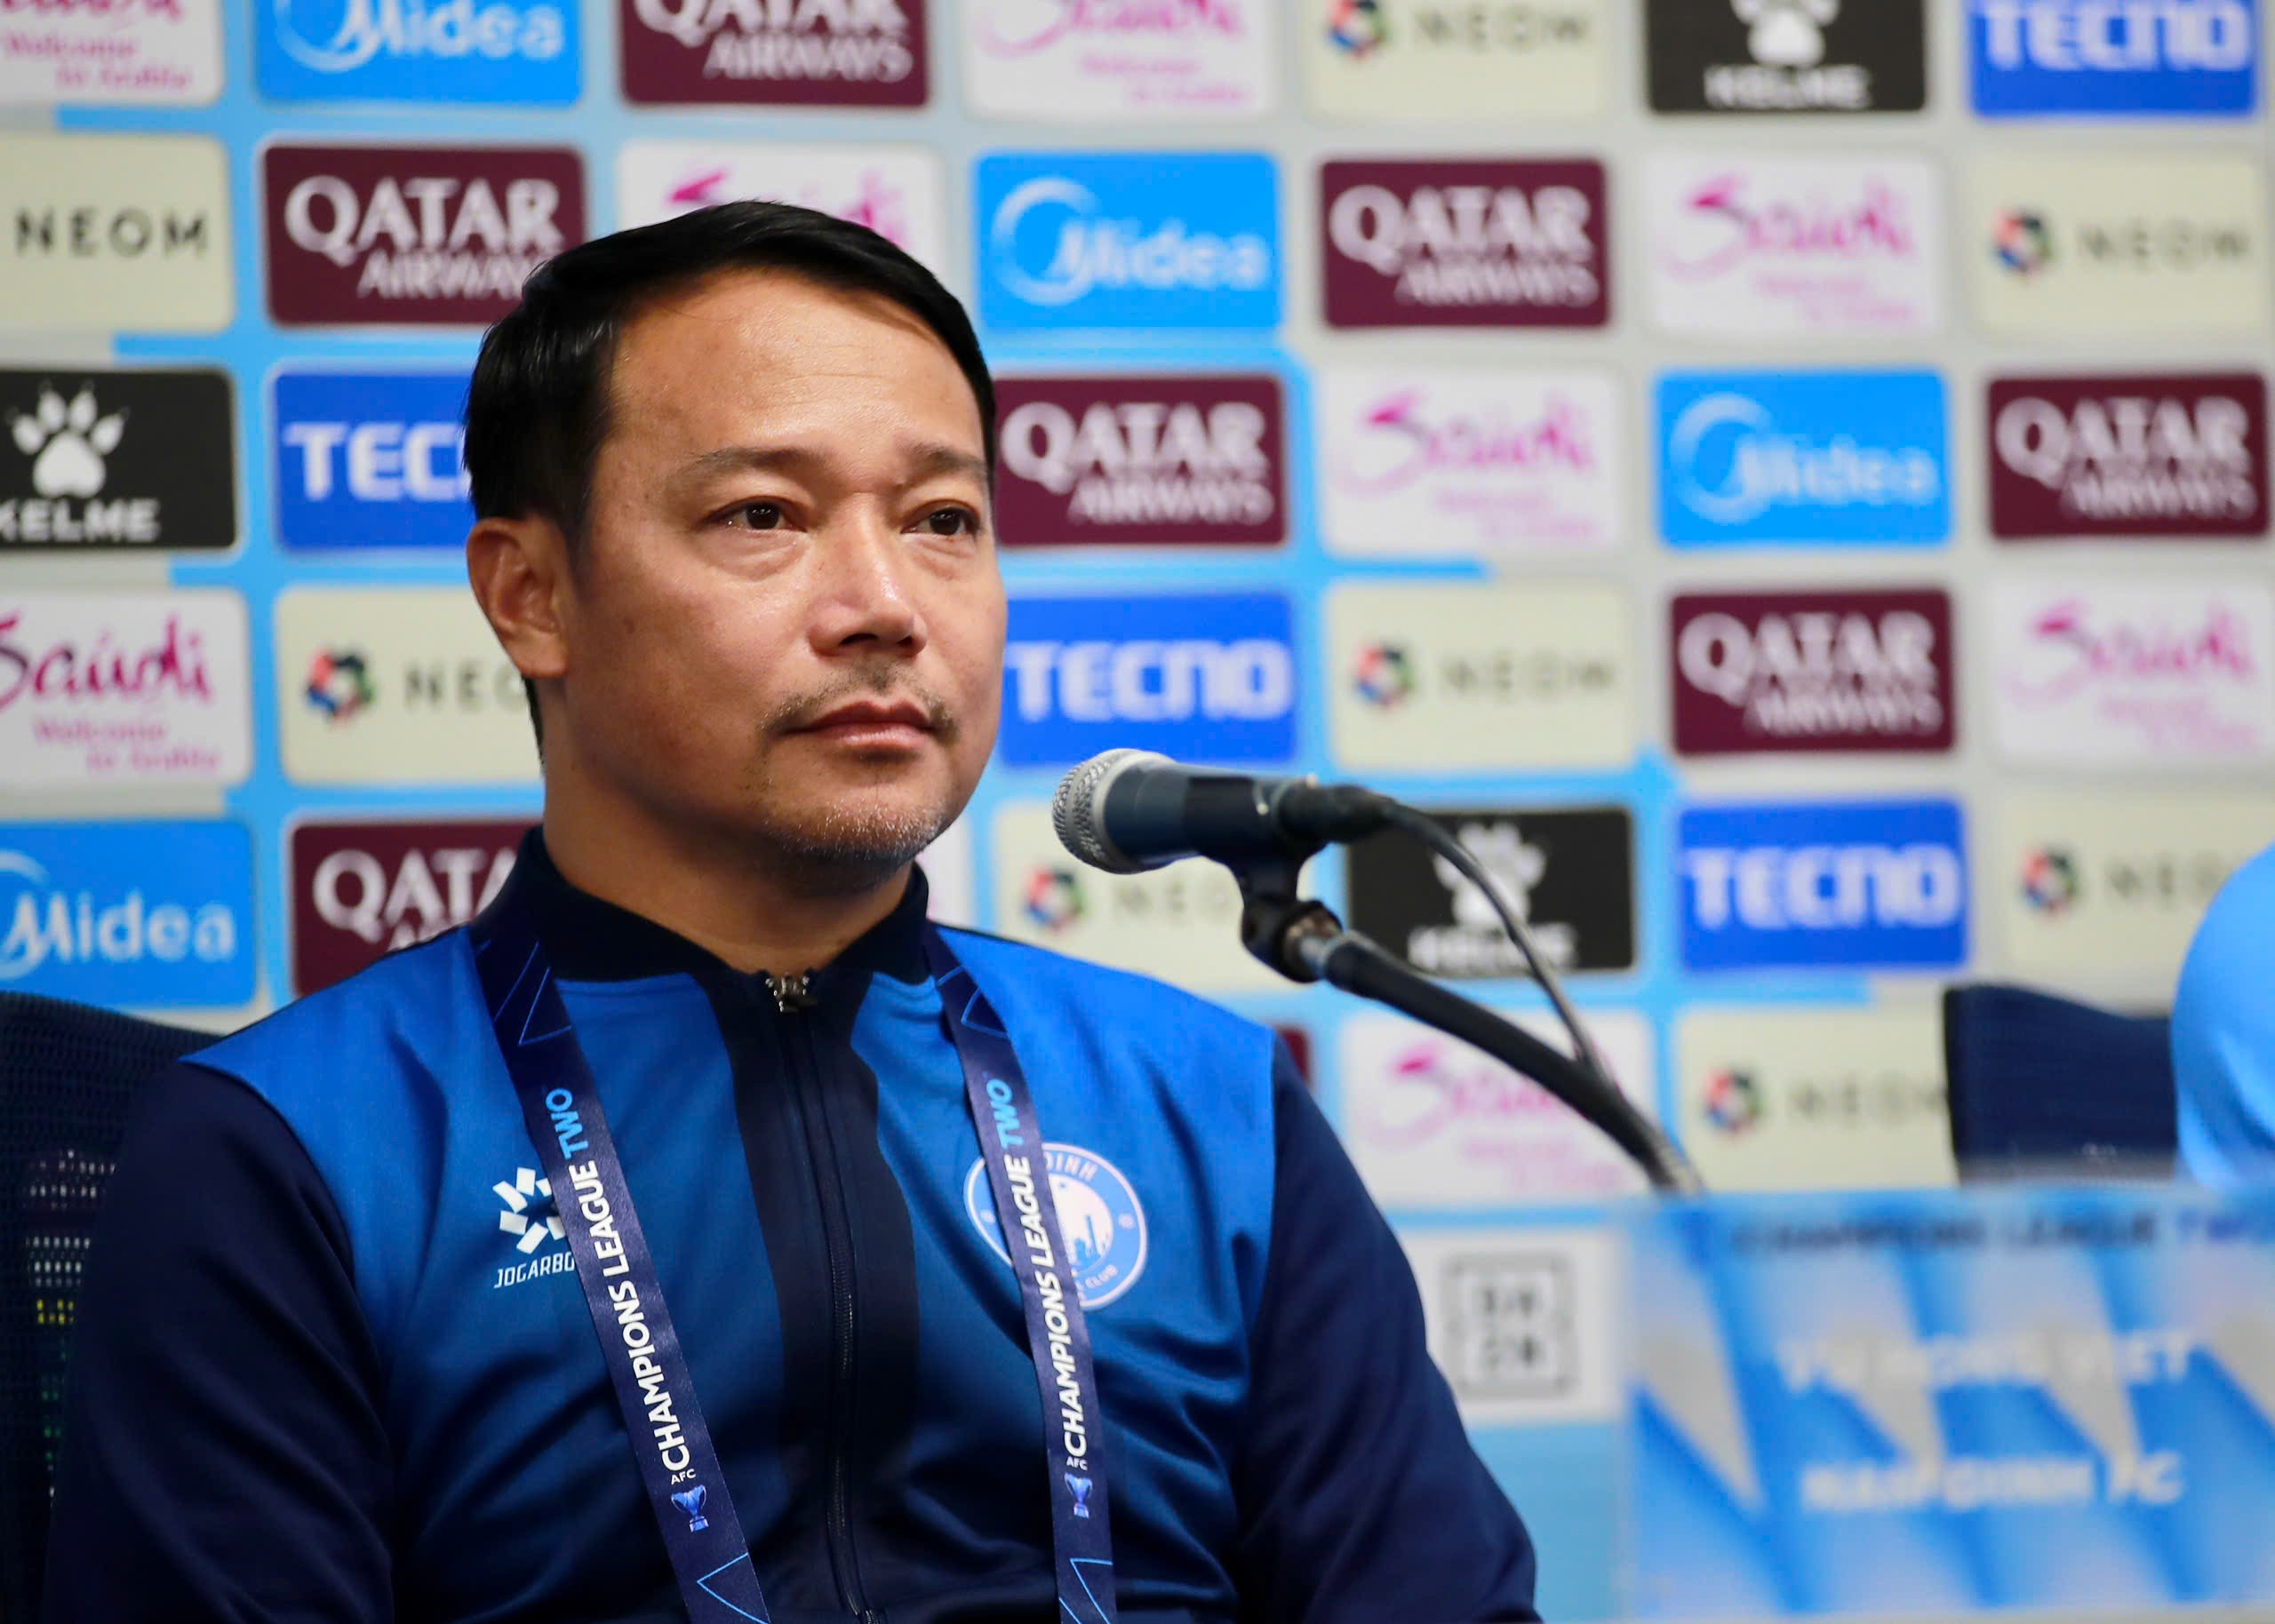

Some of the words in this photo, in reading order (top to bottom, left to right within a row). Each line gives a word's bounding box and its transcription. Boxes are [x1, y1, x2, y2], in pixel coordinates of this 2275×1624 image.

[15, 206, 210, 258] NEOM
[285, 175, 564, 267] QATAR
[1330, 185, 1595, 276] QATAR
[283, 422, 473, 503] TEC
[1001, 402, 1269, 495] QATAR
[1996, 396, 2252, 490] QATAR
[404, 657, 528, 711] NEO
[1007, 639, 1294, 722] TECNO
[1677, 610, 1939, 708] QATAR
[0, 886, 238, 970] Midea
[312, 848, 519, 944] QAT
[1682, 843, 1964, 930] TECNO
[545, 1087, 589, 1159] TWO
[986, 1079, 1024, 1150] TWO
[568, 1159, 630, 1278] LEAGUE
[1004, 1154, 1057, 1269] LEAGUE
[493, 1250, 576, 1289] JOGARBO
[608, 1280, 690, 1471] CHAMPIONS
[1034, 1270, 1088, 1458] CHAMPIONS
[670, 1468, 697, 1485] AFC
[1066, 1459, 1088, 1471] AFC
